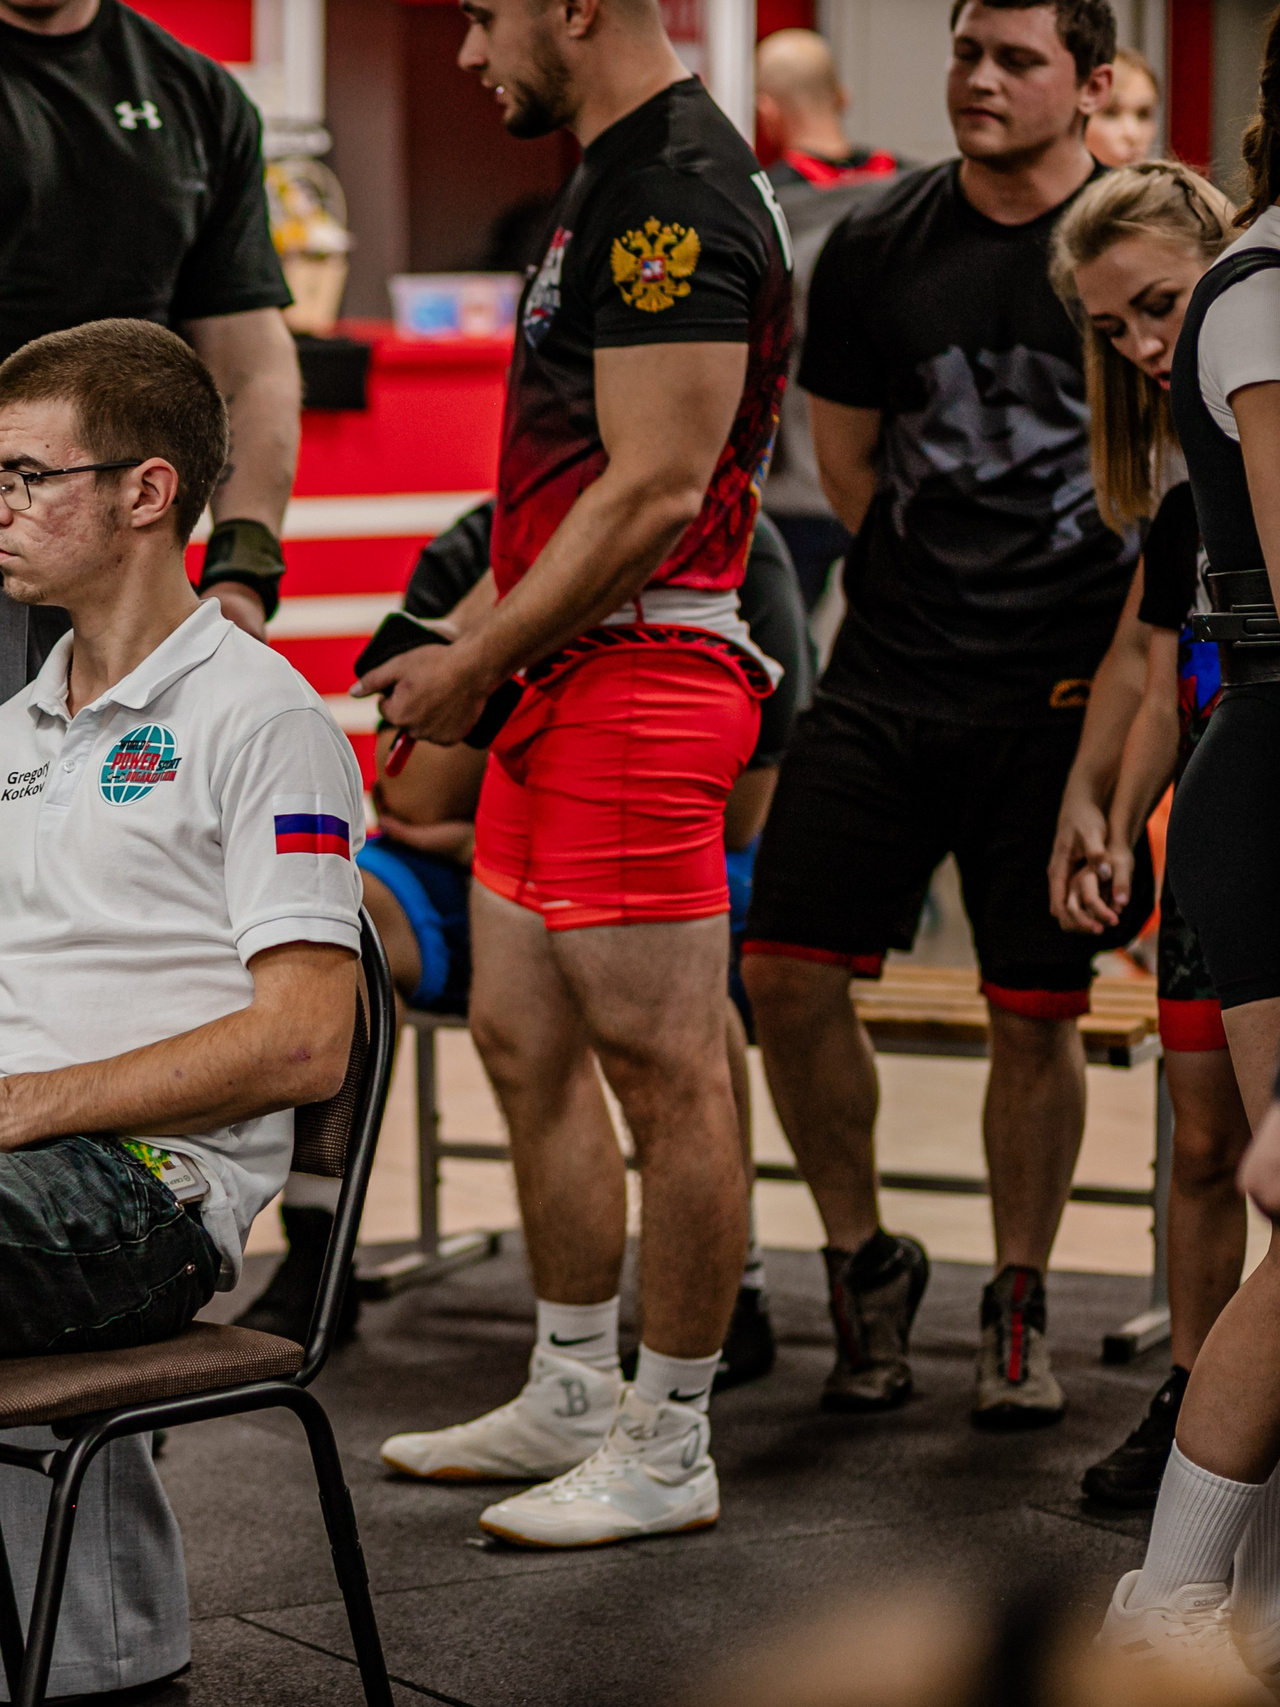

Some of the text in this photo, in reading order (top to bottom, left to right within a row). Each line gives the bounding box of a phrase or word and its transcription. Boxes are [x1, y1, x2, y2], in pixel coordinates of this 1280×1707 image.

[110, 752, 162, 771] POWER
[7, 760, 51, 785] Gregory
[1, 781, 46, 801] Kotkov
